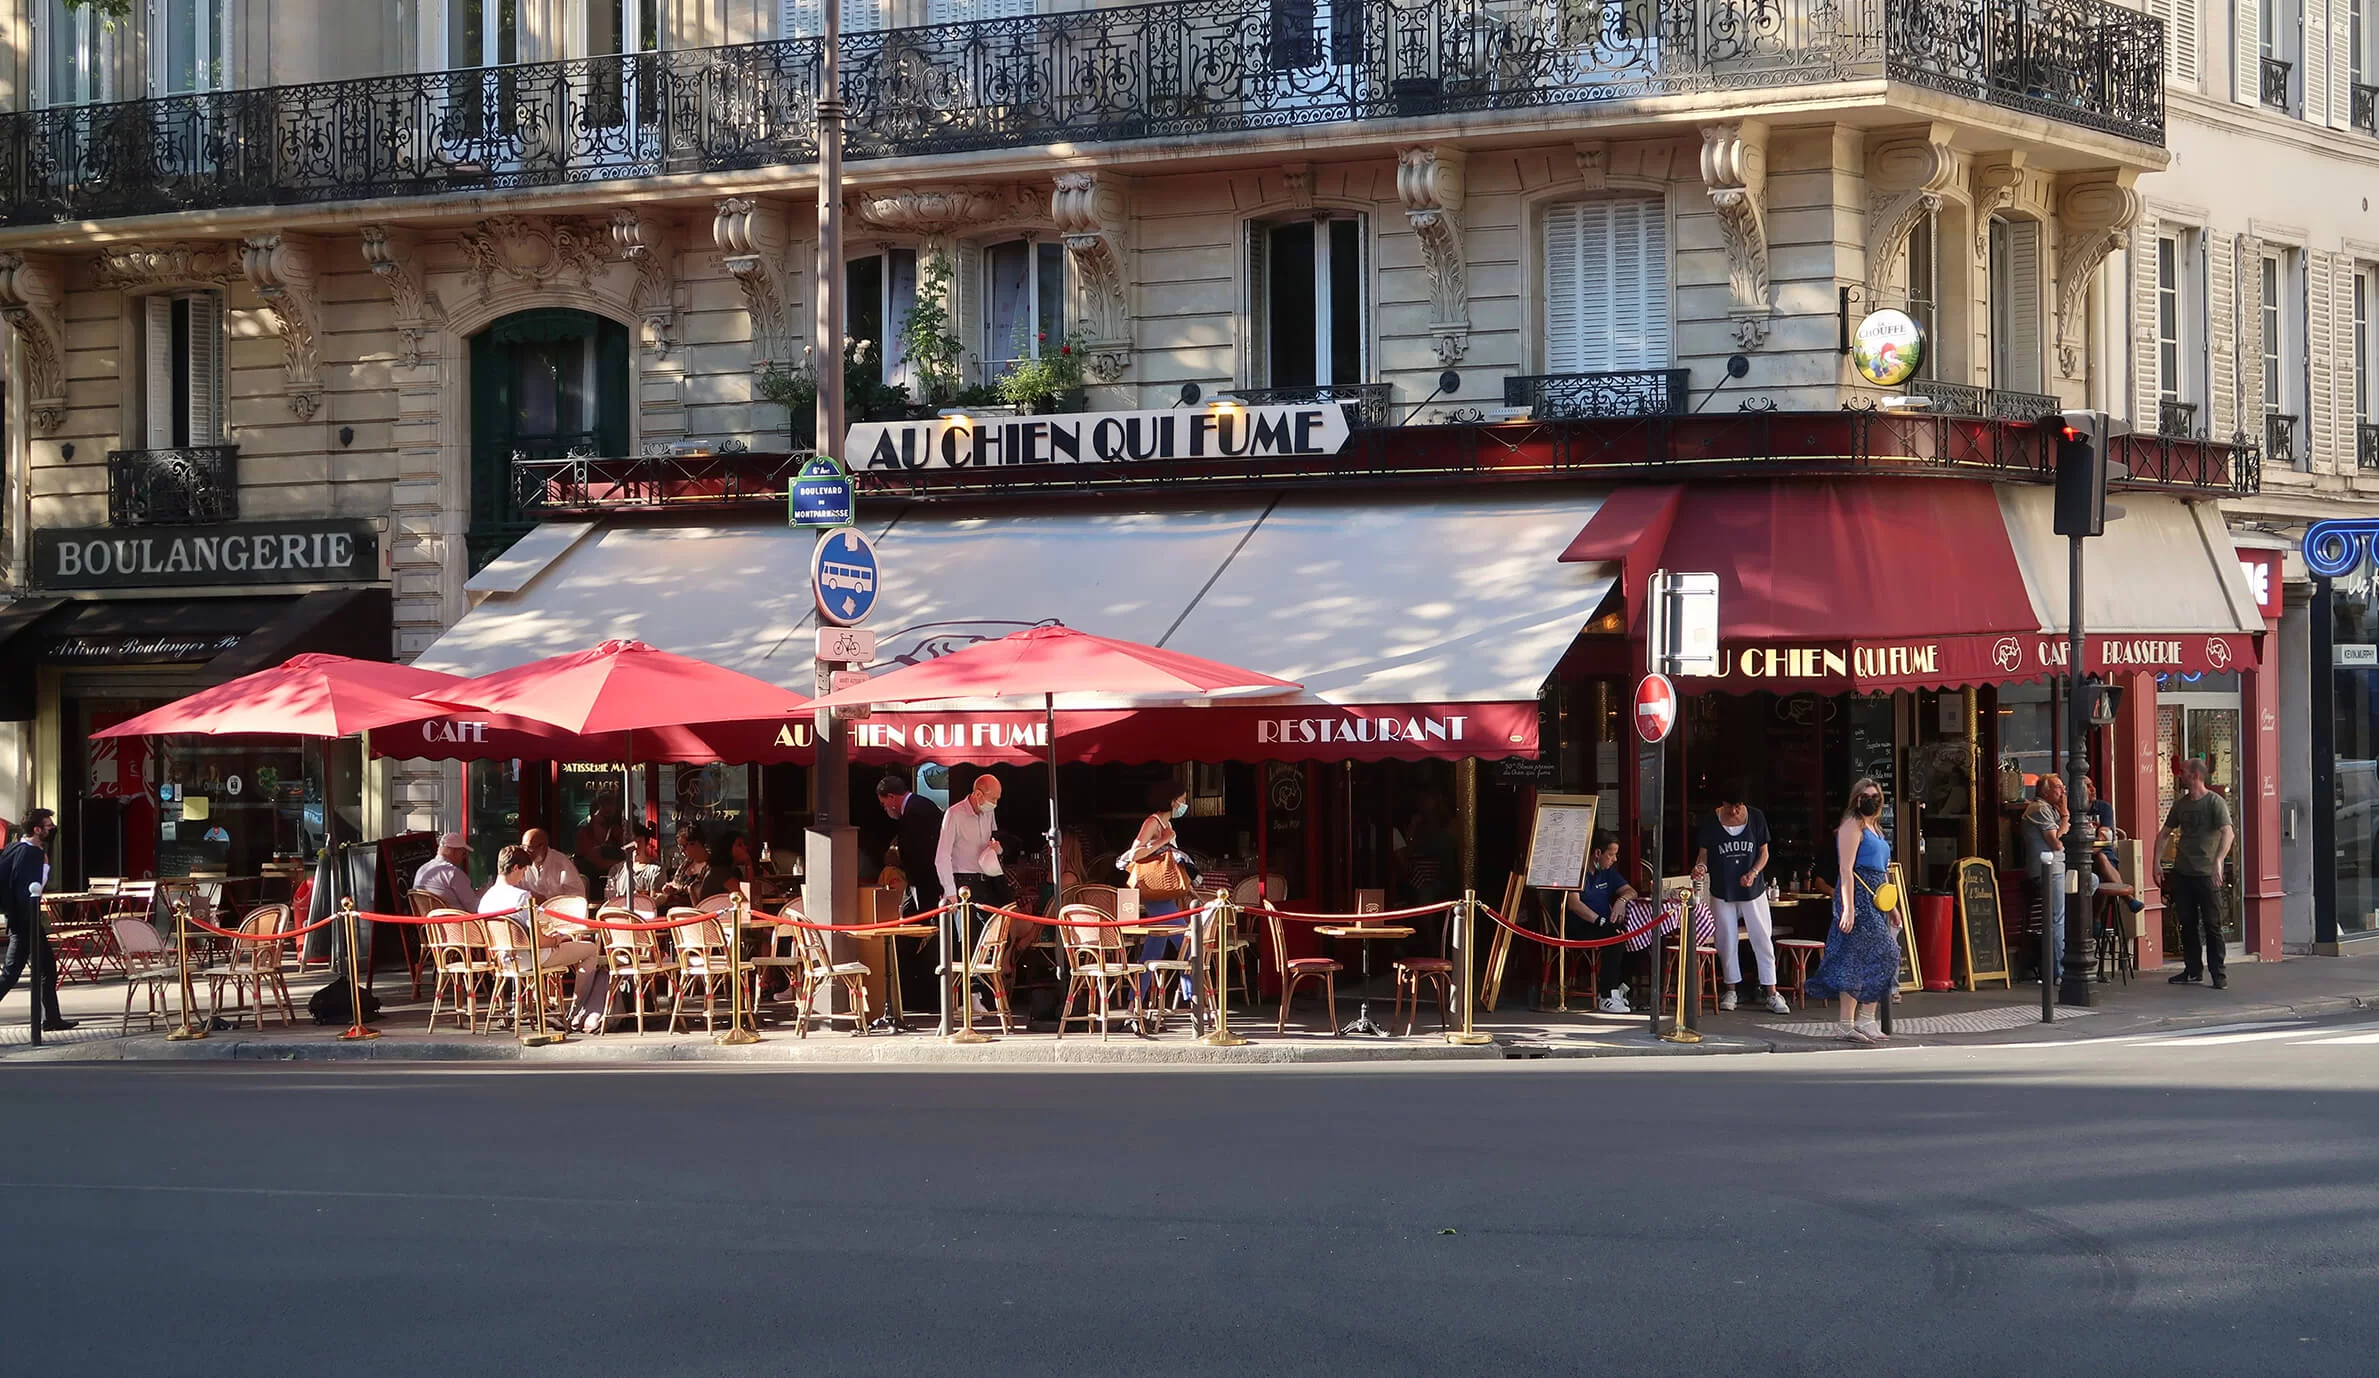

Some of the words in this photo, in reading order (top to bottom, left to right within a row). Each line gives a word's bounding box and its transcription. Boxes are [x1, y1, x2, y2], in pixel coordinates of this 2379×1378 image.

[1858, 323, 1907, 339] CHOUFFE
[868, 426, 931, 470] AU
[941, 419, 1081, 468] CHIEN
[1092, 415, 1175, 464] QUI
[1190, 410, 1324, 458] FUME
[800, 486, 842, 495] BOULEVARD
[794, 509, 848, 518] MONTPARNASSE
[56, 532, 353, 576] BOULANGERIE
[49, 638, 112, 657] Artisan
[118, 637, 204, 658] Boulanger
[2038, 640, 2071, 666] CAF
[2102, 640, 2184, 665] BRASSERIE
[1740, 647, 1847, 678] CHIEN
[1853, 645, 1887, 679] QUI
[1889, 644, 1940, 676] FUME
[421, 719, 490, 743] CAFE
[773, 723, 814, 747] AU
[913, 723, 965, 749] QUI
[971, 723, 1049, 747] FUME
[1257, 715, 1468, 744] RESTAURANT
[1718, 840, 1754, 855] AMOUR
